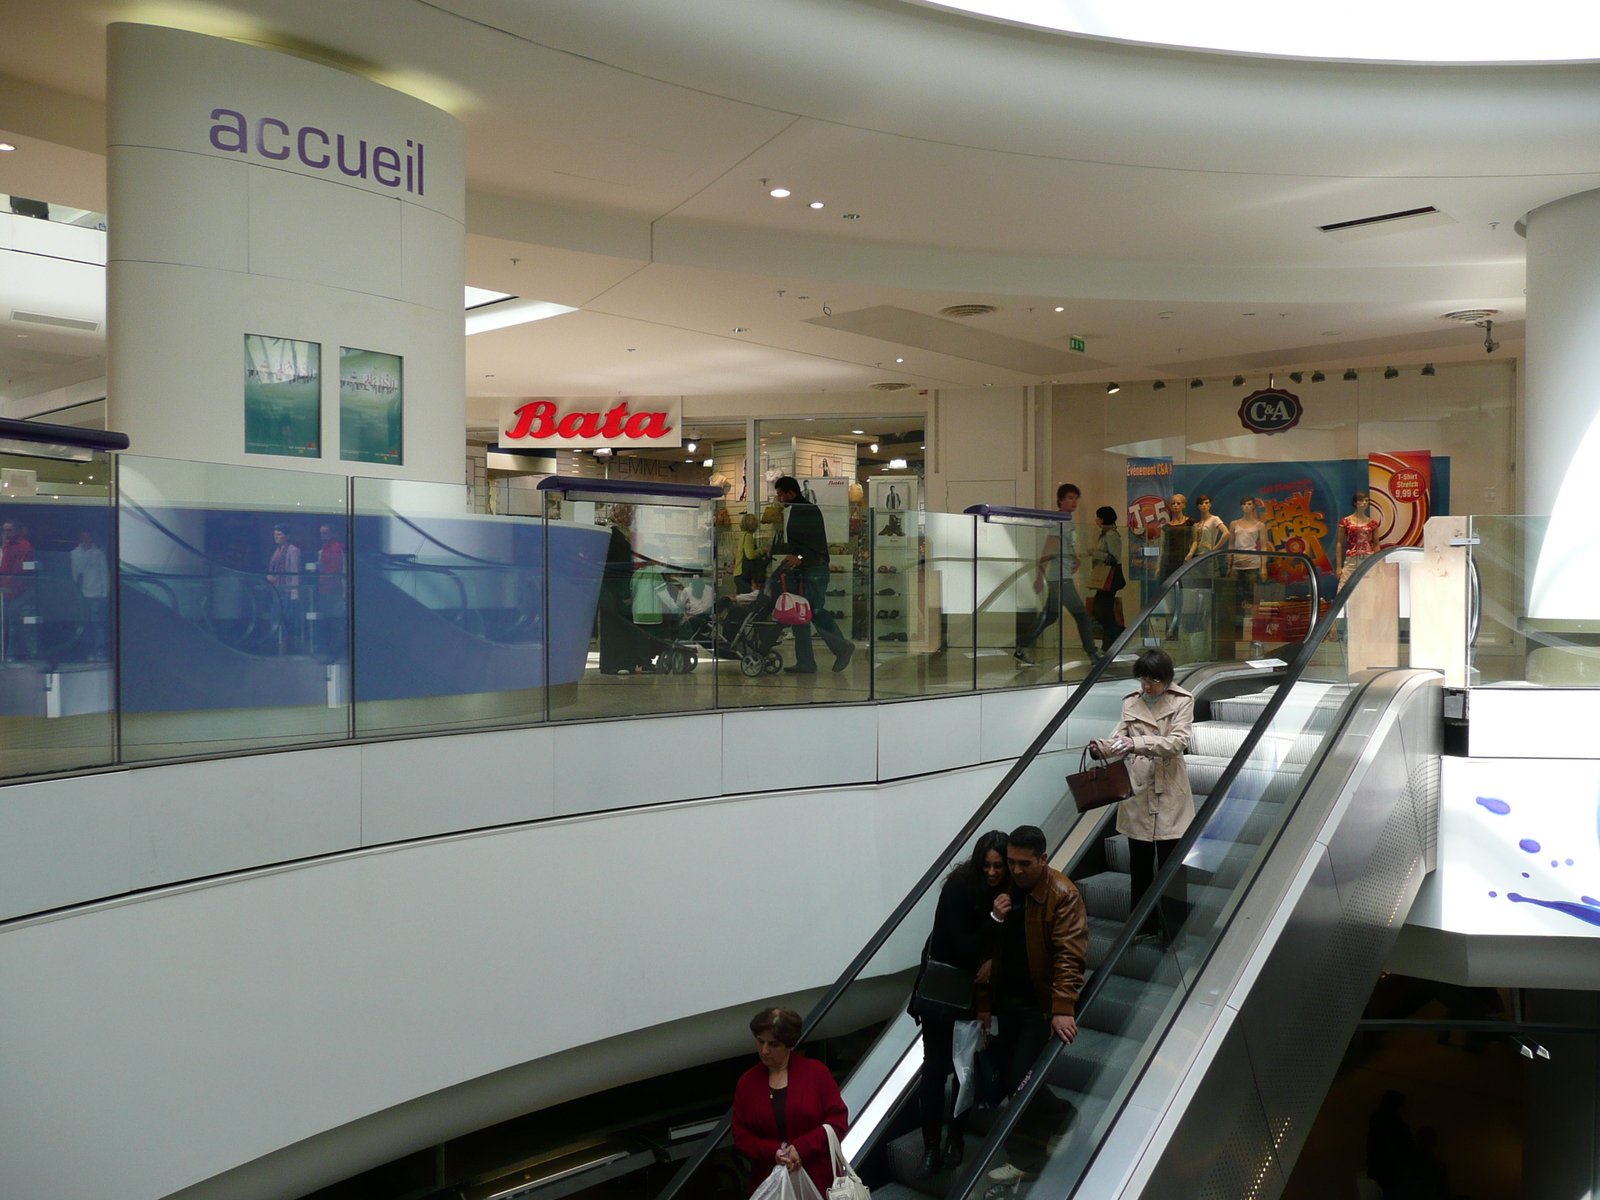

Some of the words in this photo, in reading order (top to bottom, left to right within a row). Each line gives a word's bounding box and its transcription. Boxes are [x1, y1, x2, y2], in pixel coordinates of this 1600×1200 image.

[209, 108, 424, 196] accueil
[505, 401, 671, 439] Bata
[1250, 401, 1291, 422] C&A
